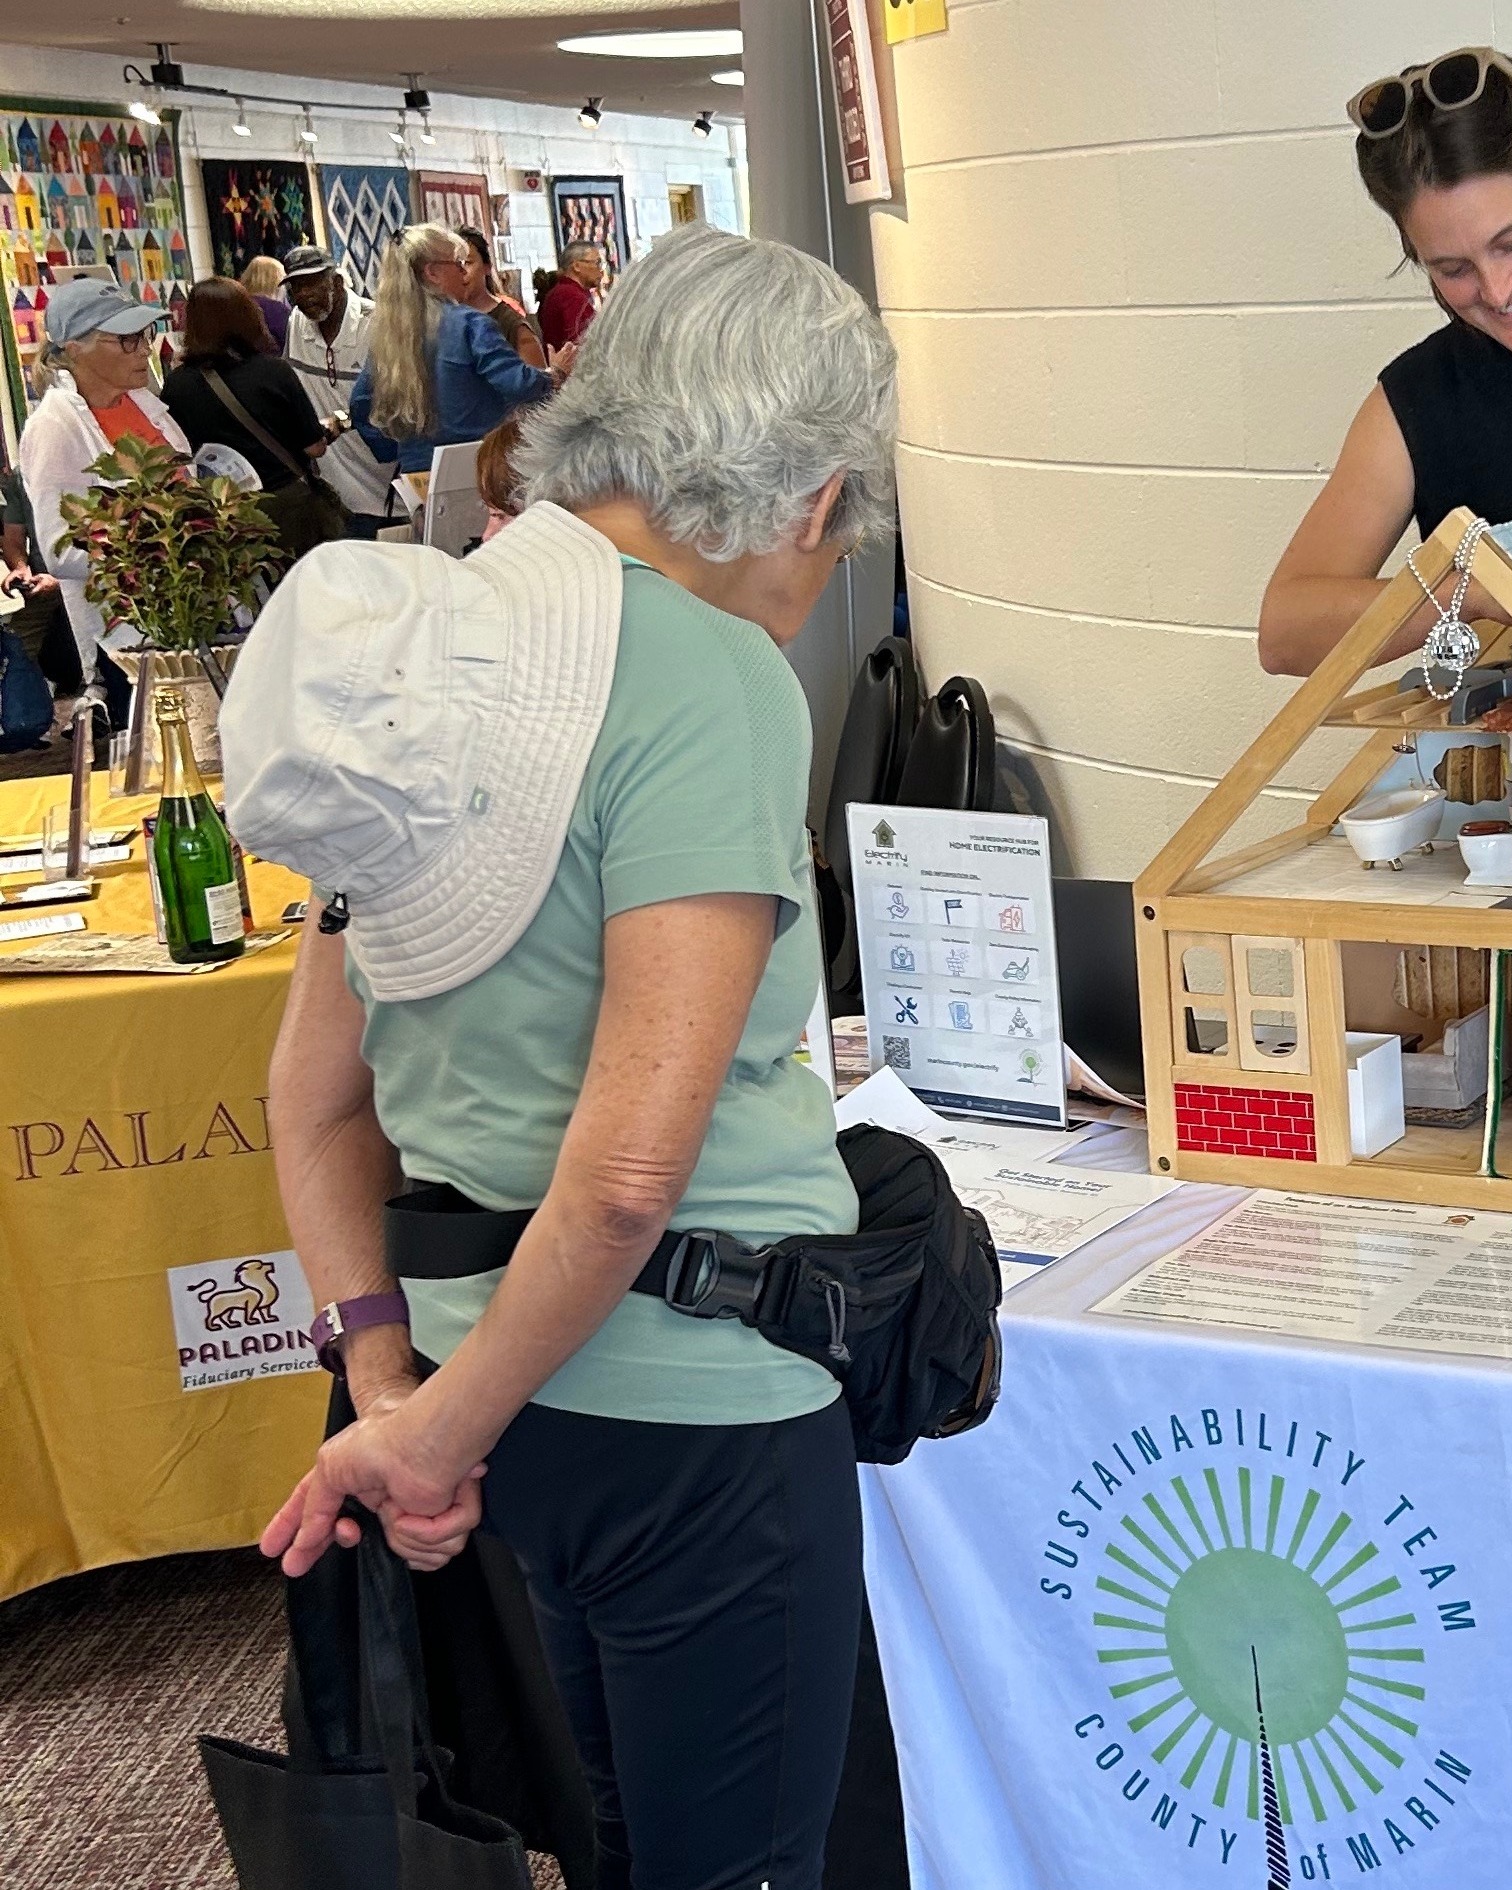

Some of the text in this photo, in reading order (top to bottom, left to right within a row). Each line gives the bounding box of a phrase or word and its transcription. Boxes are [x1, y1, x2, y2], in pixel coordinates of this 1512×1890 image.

[864, 850, 908, 863] Electrify
[949, 841, 1040, 856] HOME ELECTRIFICATION
[182, 1357, 322, 1389] Fiduciary Services
[1040, 1408, 1477, 1632] SUSTAINABILITY TEAM
[1075, 1713, 1473, 1880] COUNTY of MARIN
